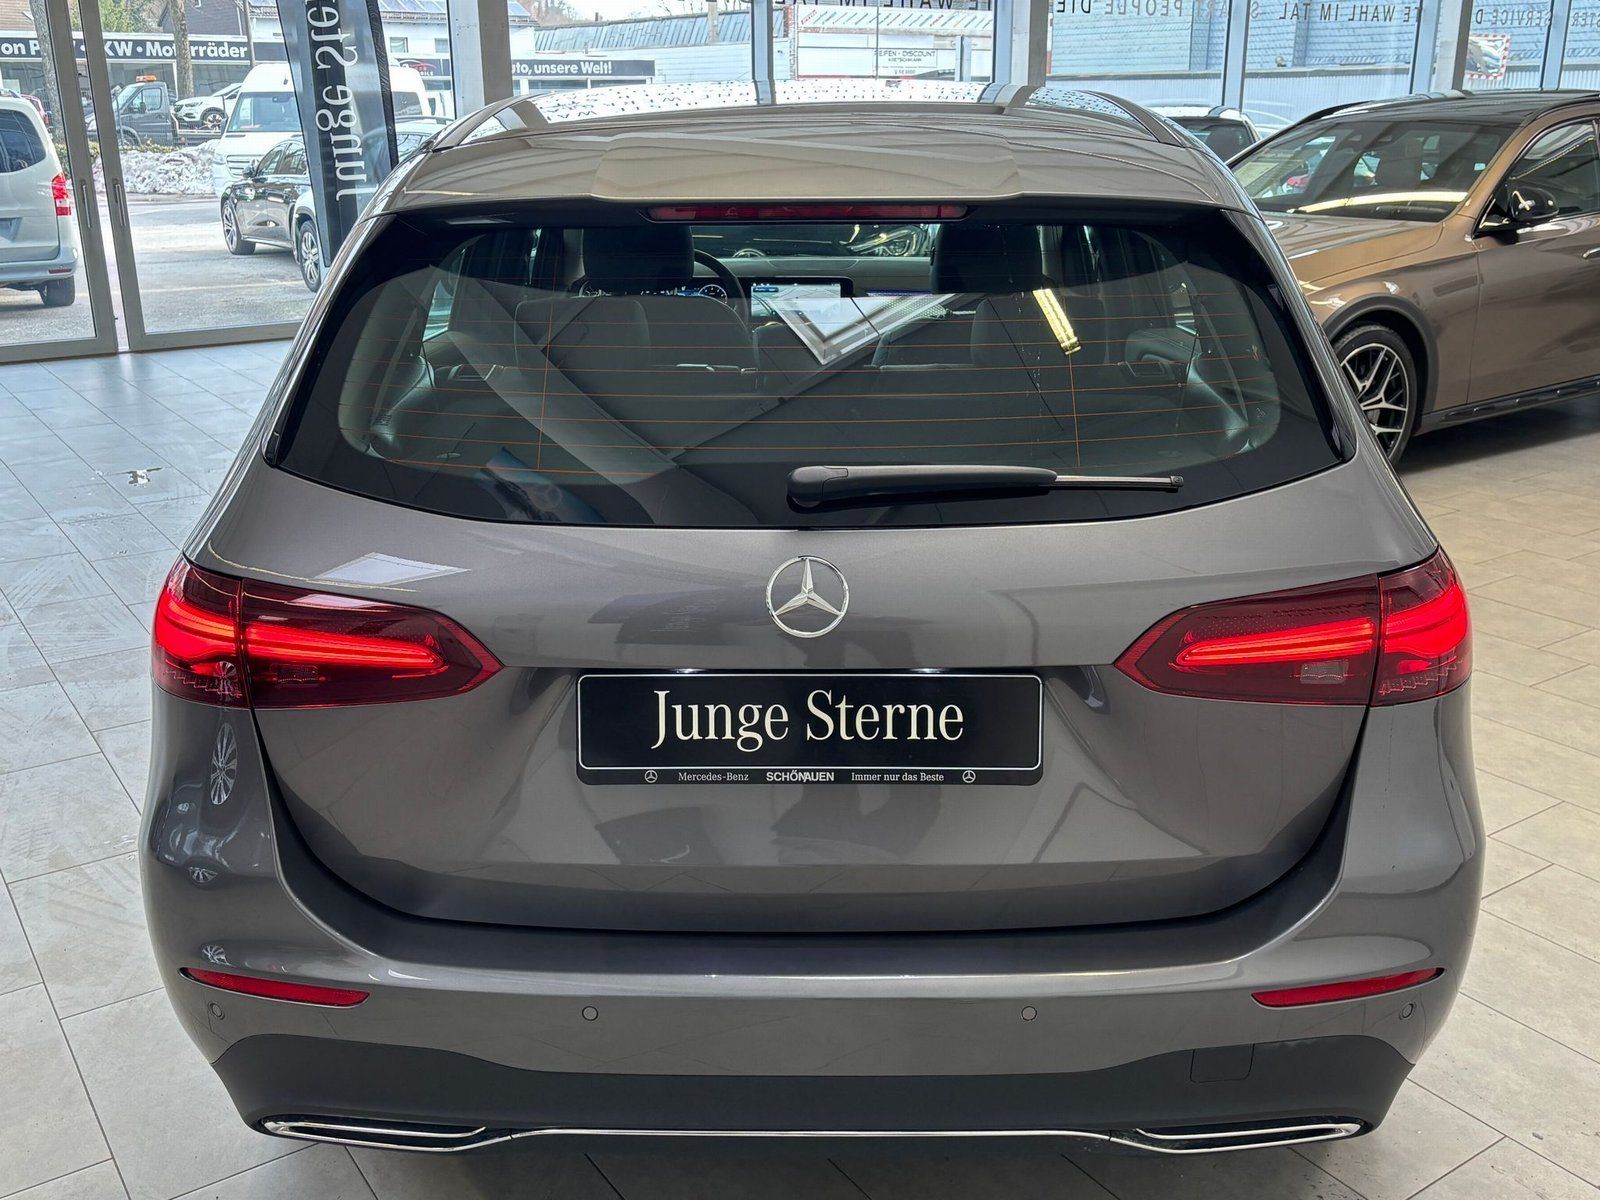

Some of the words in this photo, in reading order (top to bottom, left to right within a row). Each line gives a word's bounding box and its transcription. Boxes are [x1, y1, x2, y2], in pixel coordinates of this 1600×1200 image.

[0, 42, 26, 55] on
[146, 40, 248, 58] Motrräder
[534, 63, 579, 74] unsere
[580, 61, 613, 74] Welt!
[651, 690, 789, 753] Junge
[806, 689, 964, 741] Sterne
[678, 772, 749, 782] Mercedes-Benz
[766, 769, 835, 782] SCHÖNAUEN
[851, 772, 881, 781] Immer
[883, 773, 900, 781] nur
[902, 772, 918, 781] das
[920, 772, 945, 781] Beste
